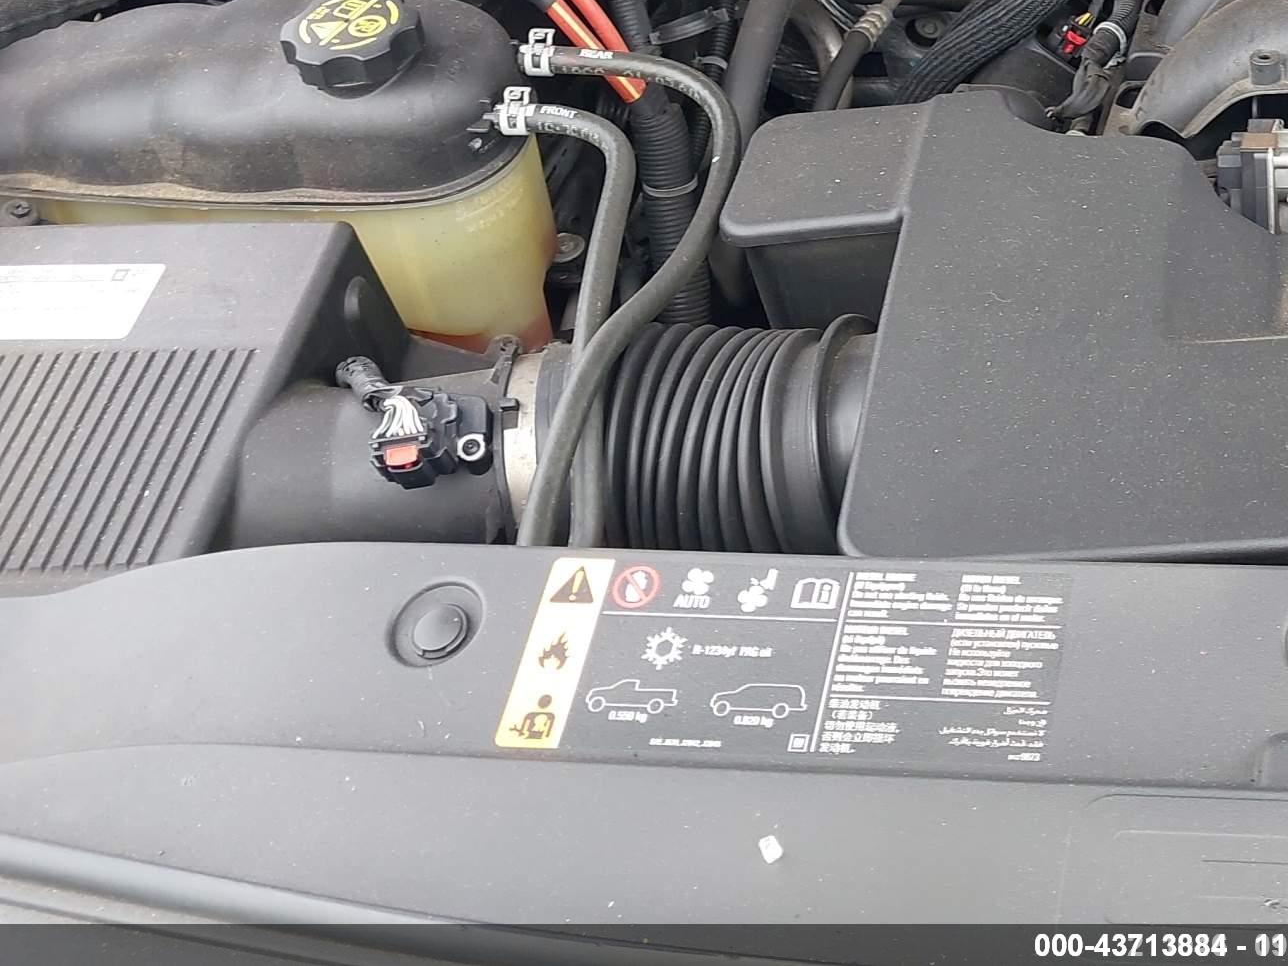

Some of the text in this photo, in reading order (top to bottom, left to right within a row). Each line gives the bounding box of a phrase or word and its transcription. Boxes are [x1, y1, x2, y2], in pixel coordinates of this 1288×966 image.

[578, 48, 614, 60] REAR
[539, 105, 578, 119] FRONT
[673, 594, 711, 609] AUTO
[635, 711, 648, 724] kg
